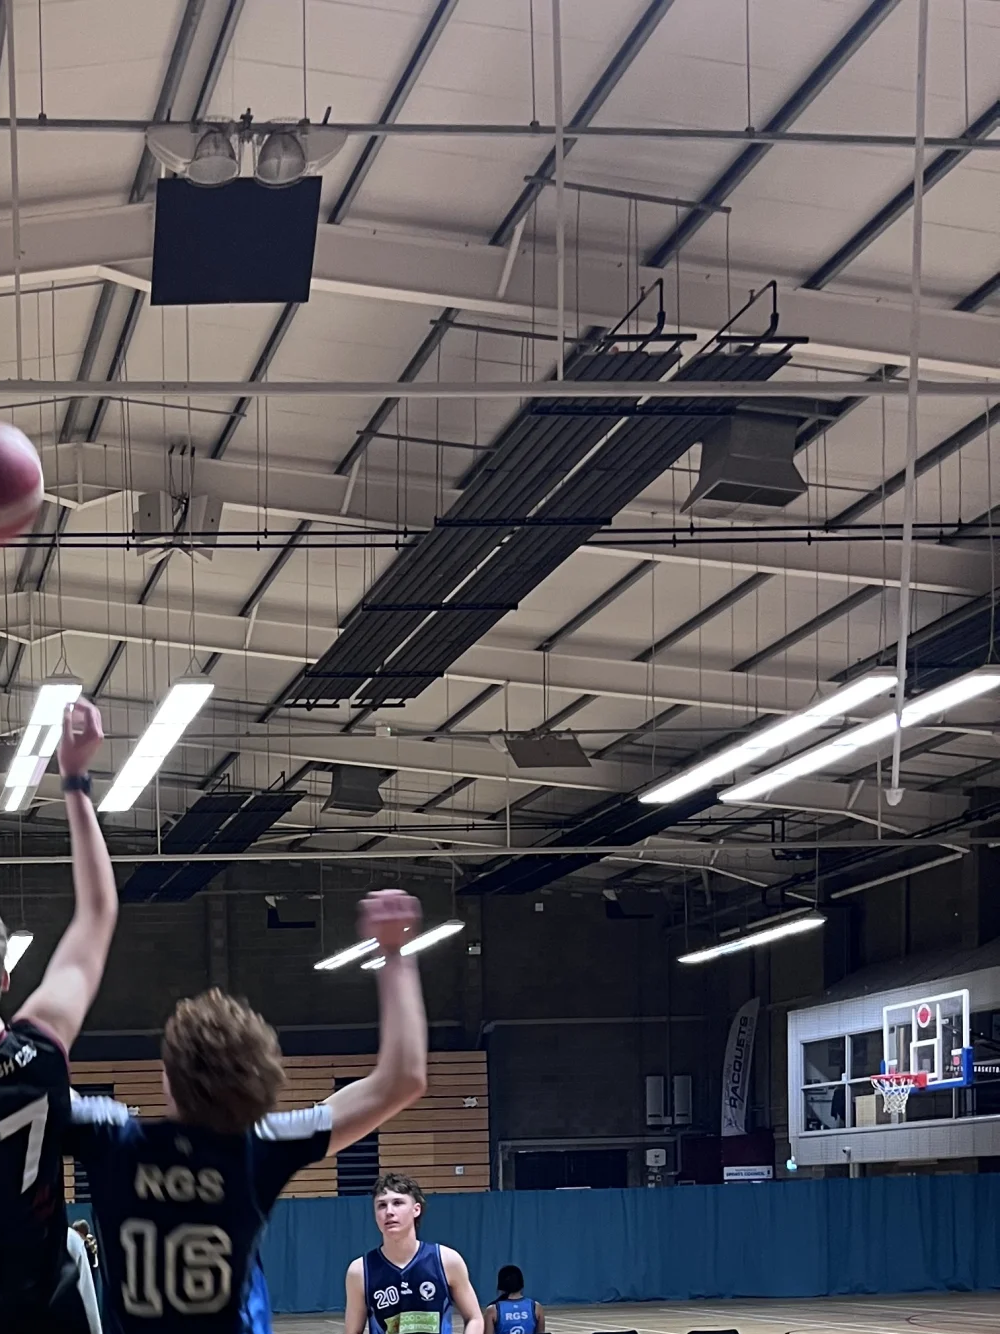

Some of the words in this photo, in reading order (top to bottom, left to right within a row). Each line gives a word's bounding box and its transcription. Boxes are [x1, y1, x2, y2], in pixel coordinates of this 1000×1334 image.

[729, 1015, 748, 1109] RACQUETS
[973, 1065, 1000, 1073] BASKETB
[134, 1161, 226, 1204] RGS
[119, 1217, 233, 1319] 16
[373, 1285, 400, 1310] 20
[399, 1323, 438, 1333] pharmacy
[505, 1311, 529, 1321] RGS
